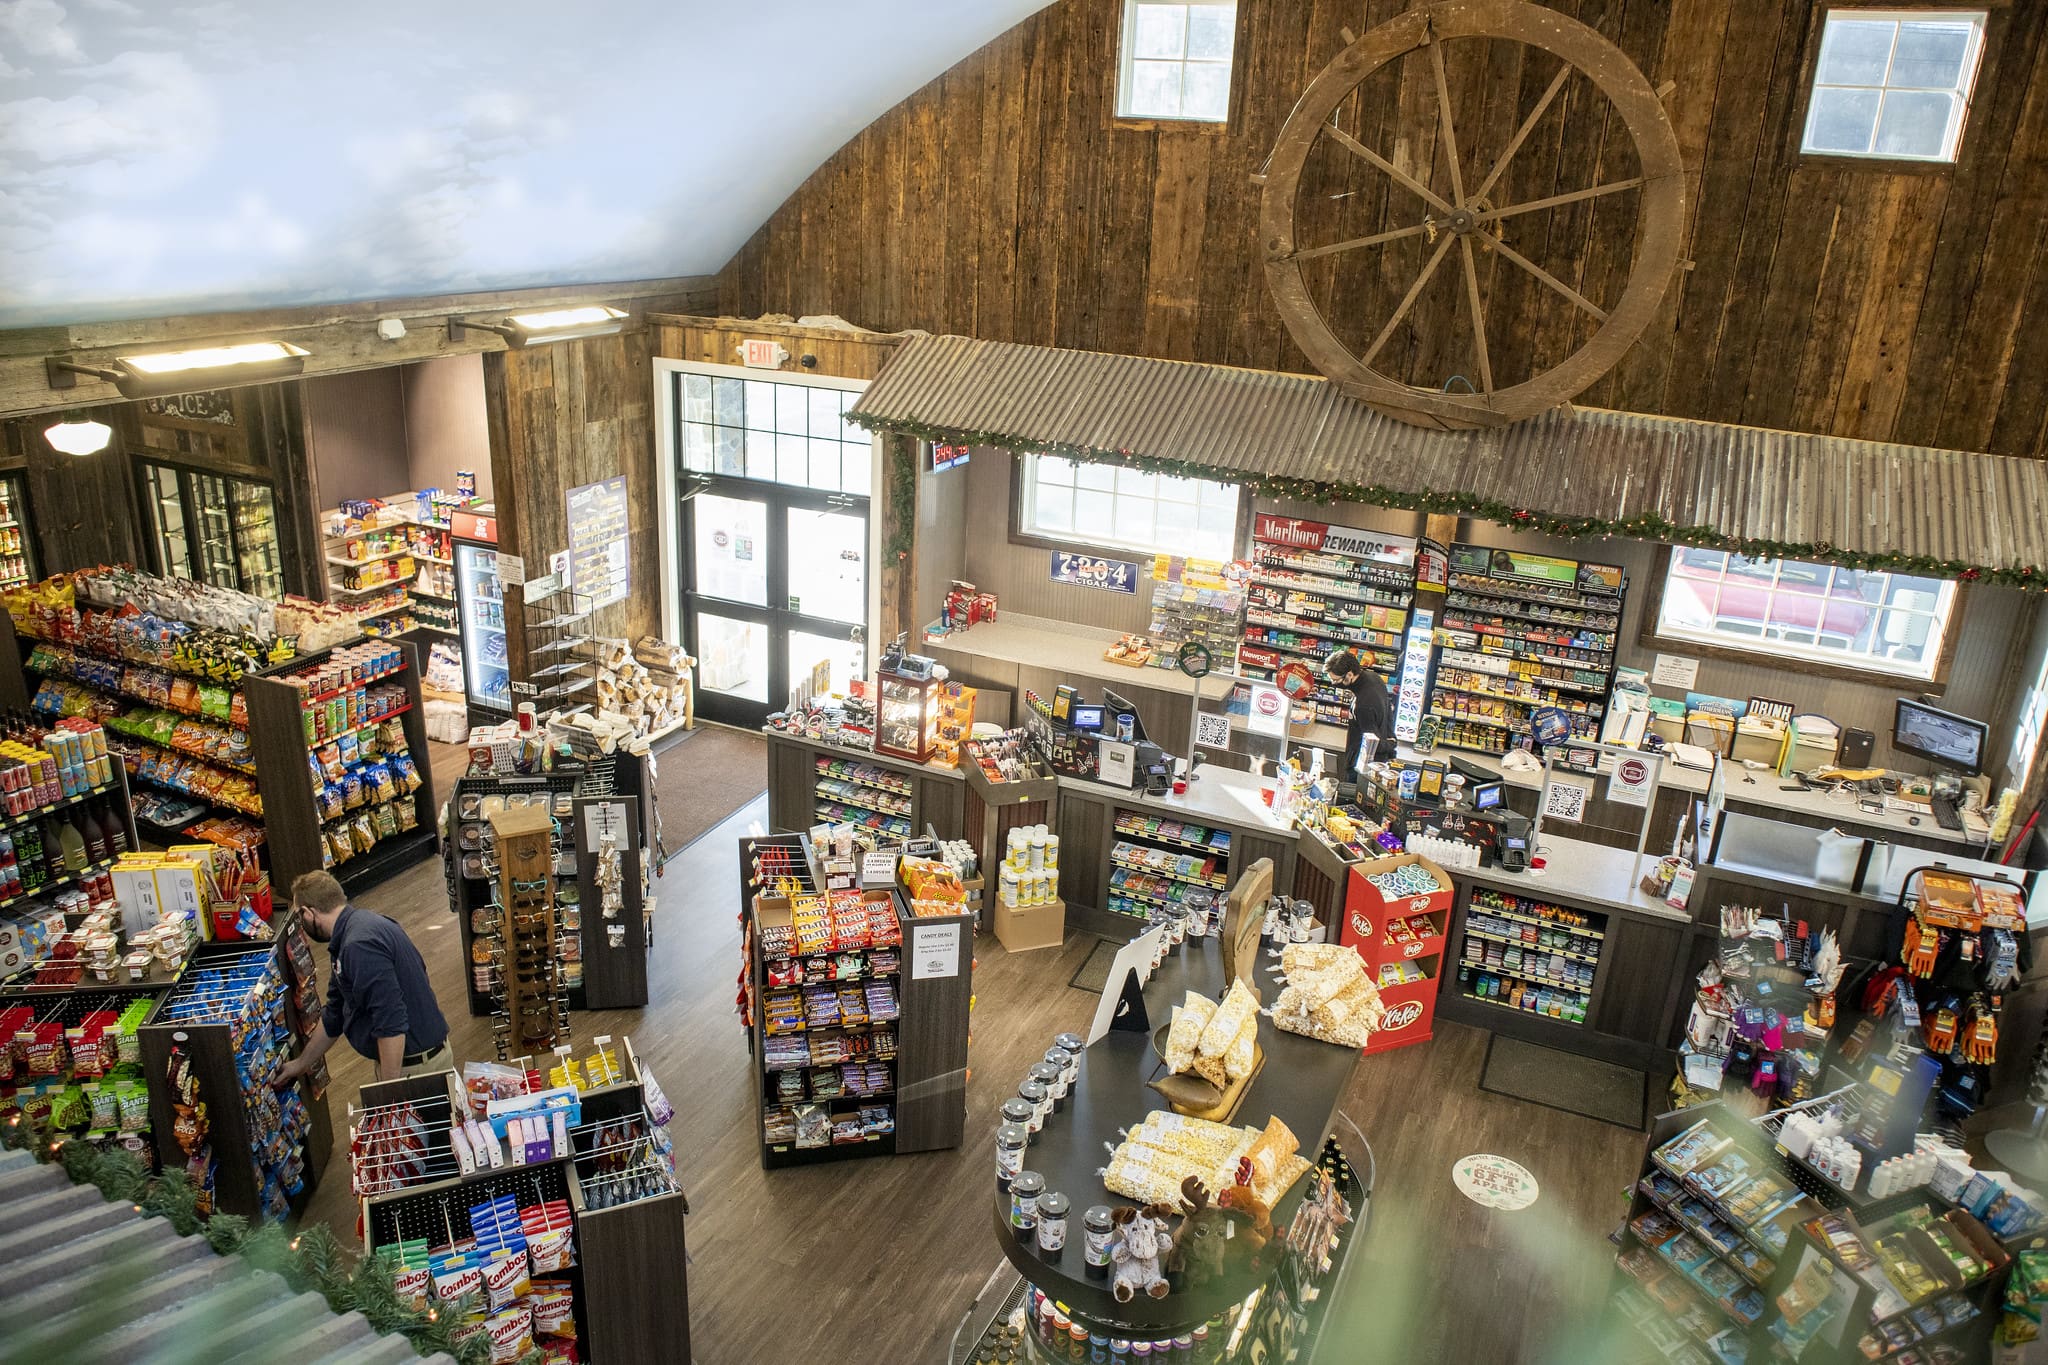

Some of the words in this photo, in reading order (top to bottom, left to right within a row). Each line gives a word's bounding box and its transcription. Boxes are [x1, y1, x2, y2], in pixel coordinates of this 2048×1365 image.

[748, 342, 773, 364] EXIT
[177, 394, 208, 415] ICE
[1264, 519, 1319, 546] Marlboro
[1075, 578, 1109, 588] CIGAR
[1241, 650, 1271, 662] Newport
[1352, 914, 1373, 936] KitKat
[1381, 1006, 1421, 1031] KitKat
[26, 1043, 54, 1054] GIANTS
[72, 1043, 97, 1055] GIANTS
[121, 1096, 149, 1110] GIANTS
[1476, 1163, 1499, 1173] PLEASE
[1472, 1179, 1518, 1195] APART
[487, 1251, 526, 1287] Combos
